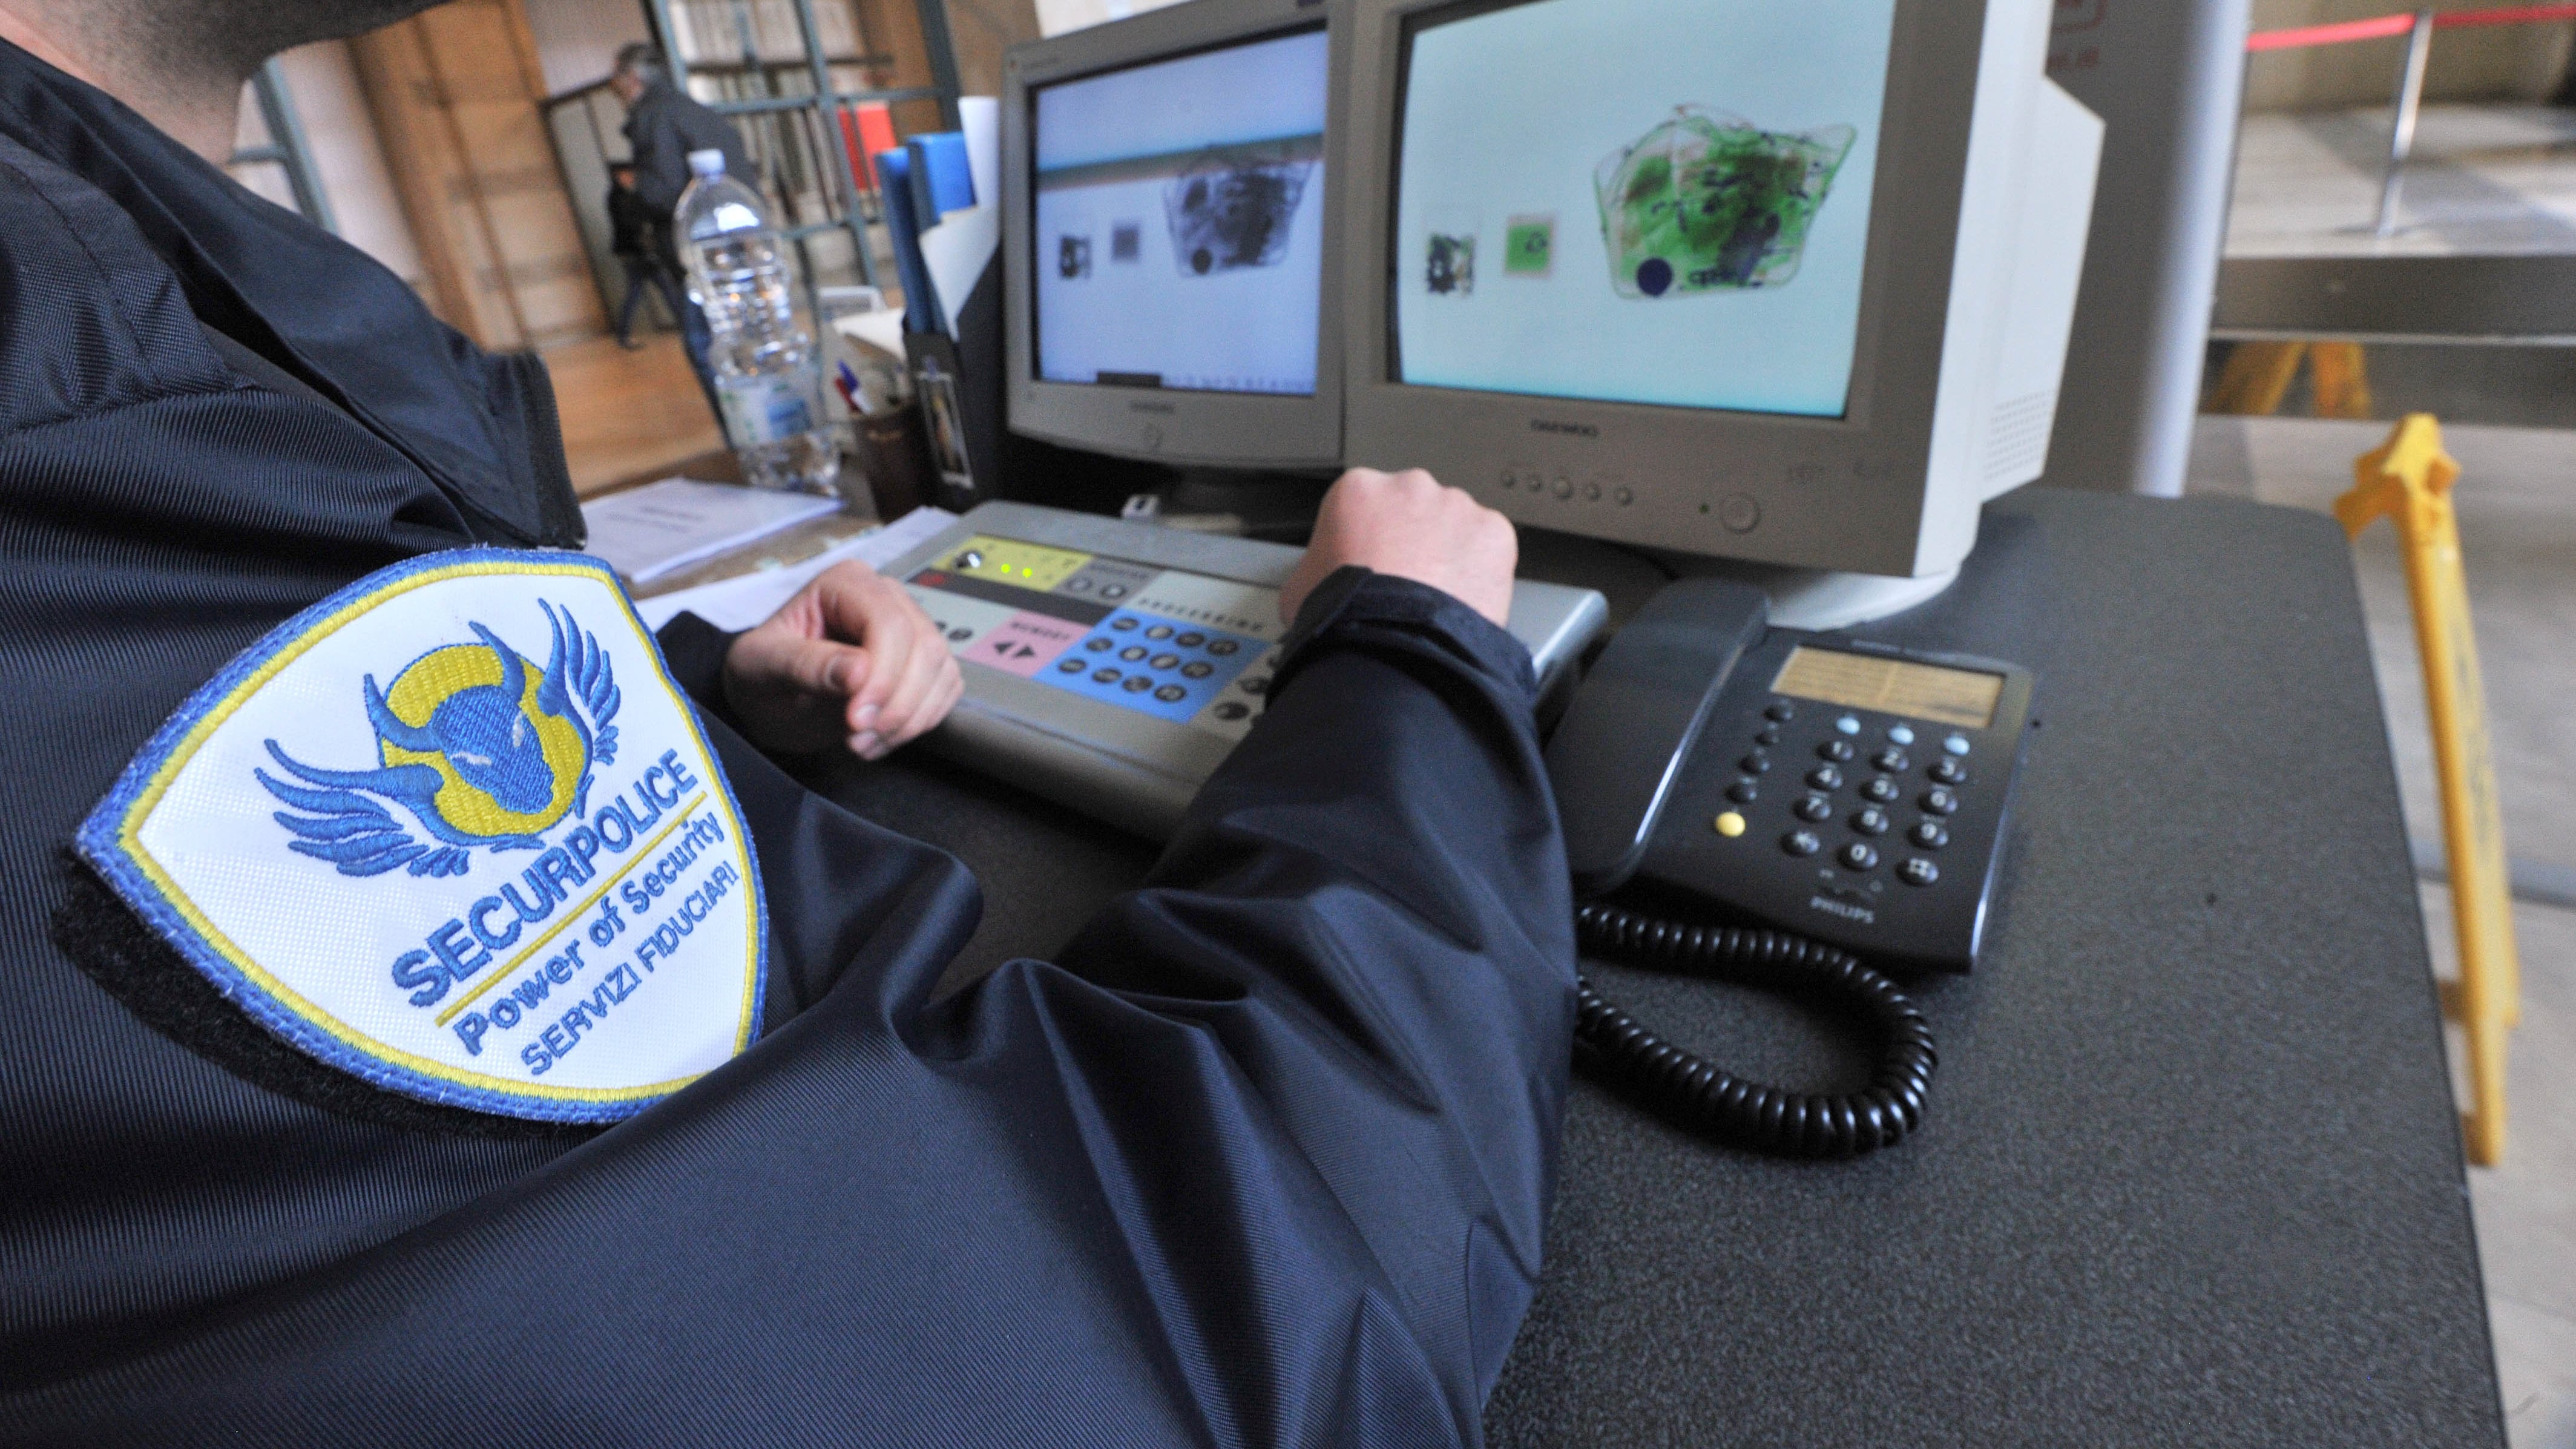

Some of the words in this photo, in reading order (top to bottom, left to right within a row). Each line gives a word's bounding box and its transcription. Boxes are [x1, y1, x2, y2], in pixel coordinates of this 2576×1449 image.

[391, 748, 698, 1008] SECURPOLICE
[452, 939, 585, 1057] Power
[588, 895, 626, 948] of
[620, 812, 724, 915] Security
[521, 962, 643, 1076] SERVIZI
[634, 860, 739, 973] FIDUCIARI
